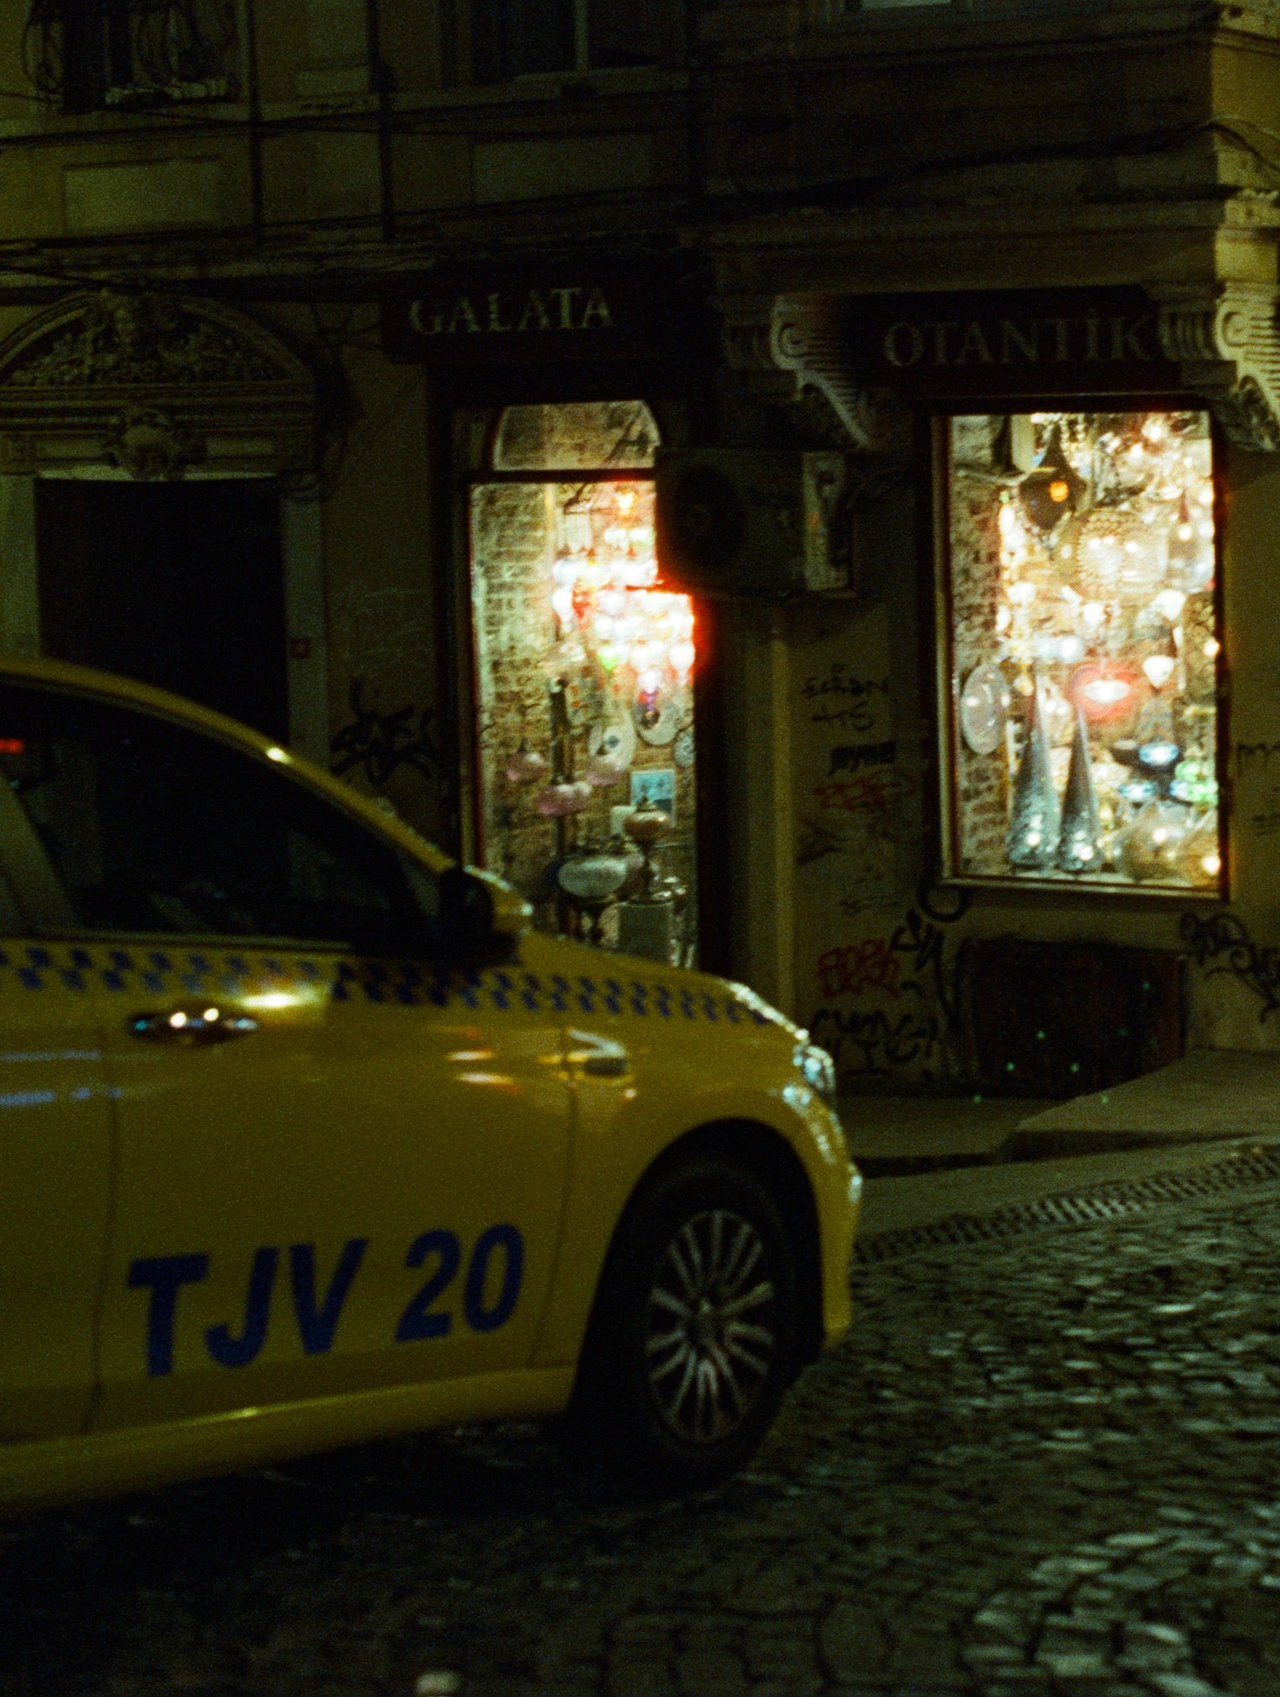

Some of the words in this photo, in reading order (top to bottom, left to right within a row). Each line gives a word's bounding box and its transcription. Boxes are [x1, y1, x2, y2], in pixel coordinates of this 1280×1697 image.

[408, 286, 617, 334] GALATA
[882, 309, 1153, 368] OTANTİK
[128, 1237, 368, 1378] TJV
[395, 1223, 525, 1343] 20
